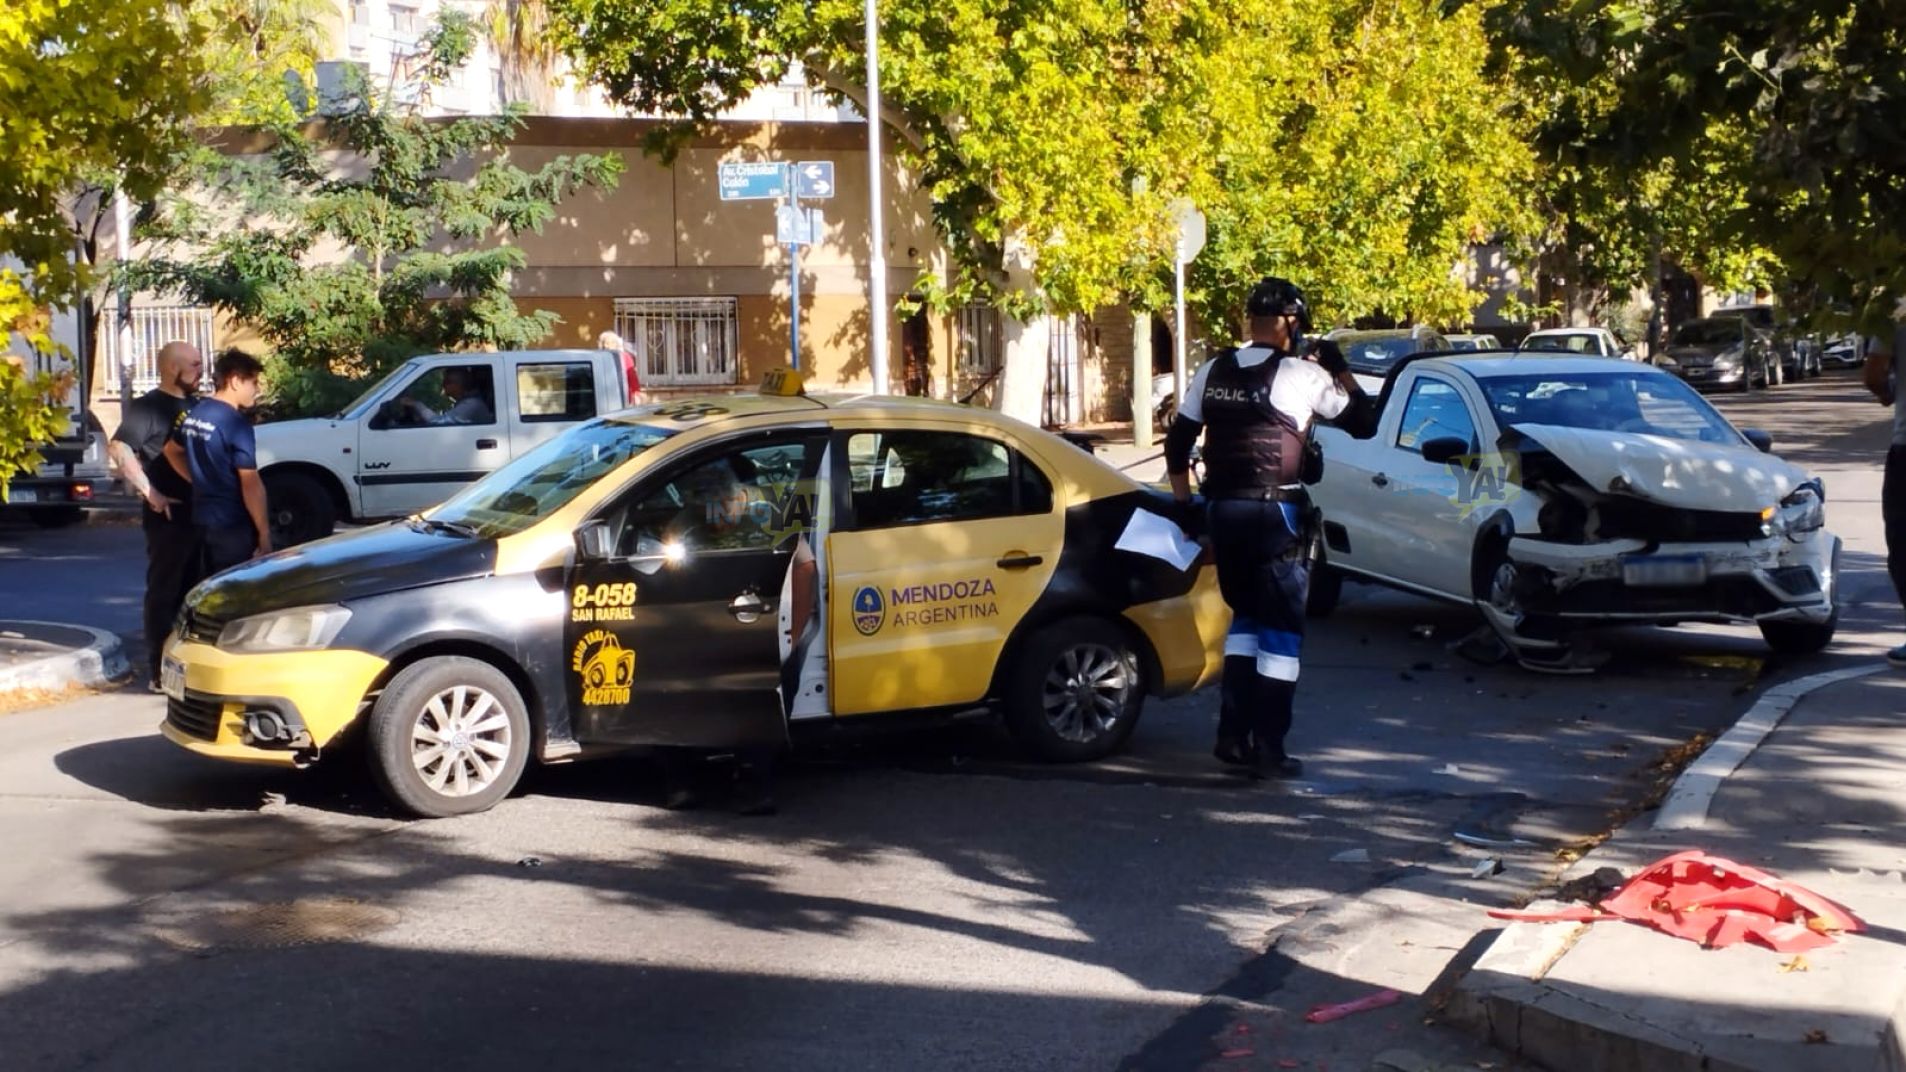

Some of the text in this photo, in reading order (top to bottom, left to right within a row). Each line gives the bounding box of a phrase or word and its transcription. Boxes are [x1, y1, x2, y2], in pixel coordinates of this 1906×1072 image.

[1206, 387, 1261, 403] POLICA
[364, 461, 391, 470] LUV
[573, 582, 637, 608] 8-058
[891, 578, 996, 606] MENDOZA
[572, 607, 636, 622] SAN RAFAEL
[893, 602, 999, 628] ARGENTINA
[573, 629, 604, 672] RADIO TAXI
[582, 687, 631, 706] 4428700
